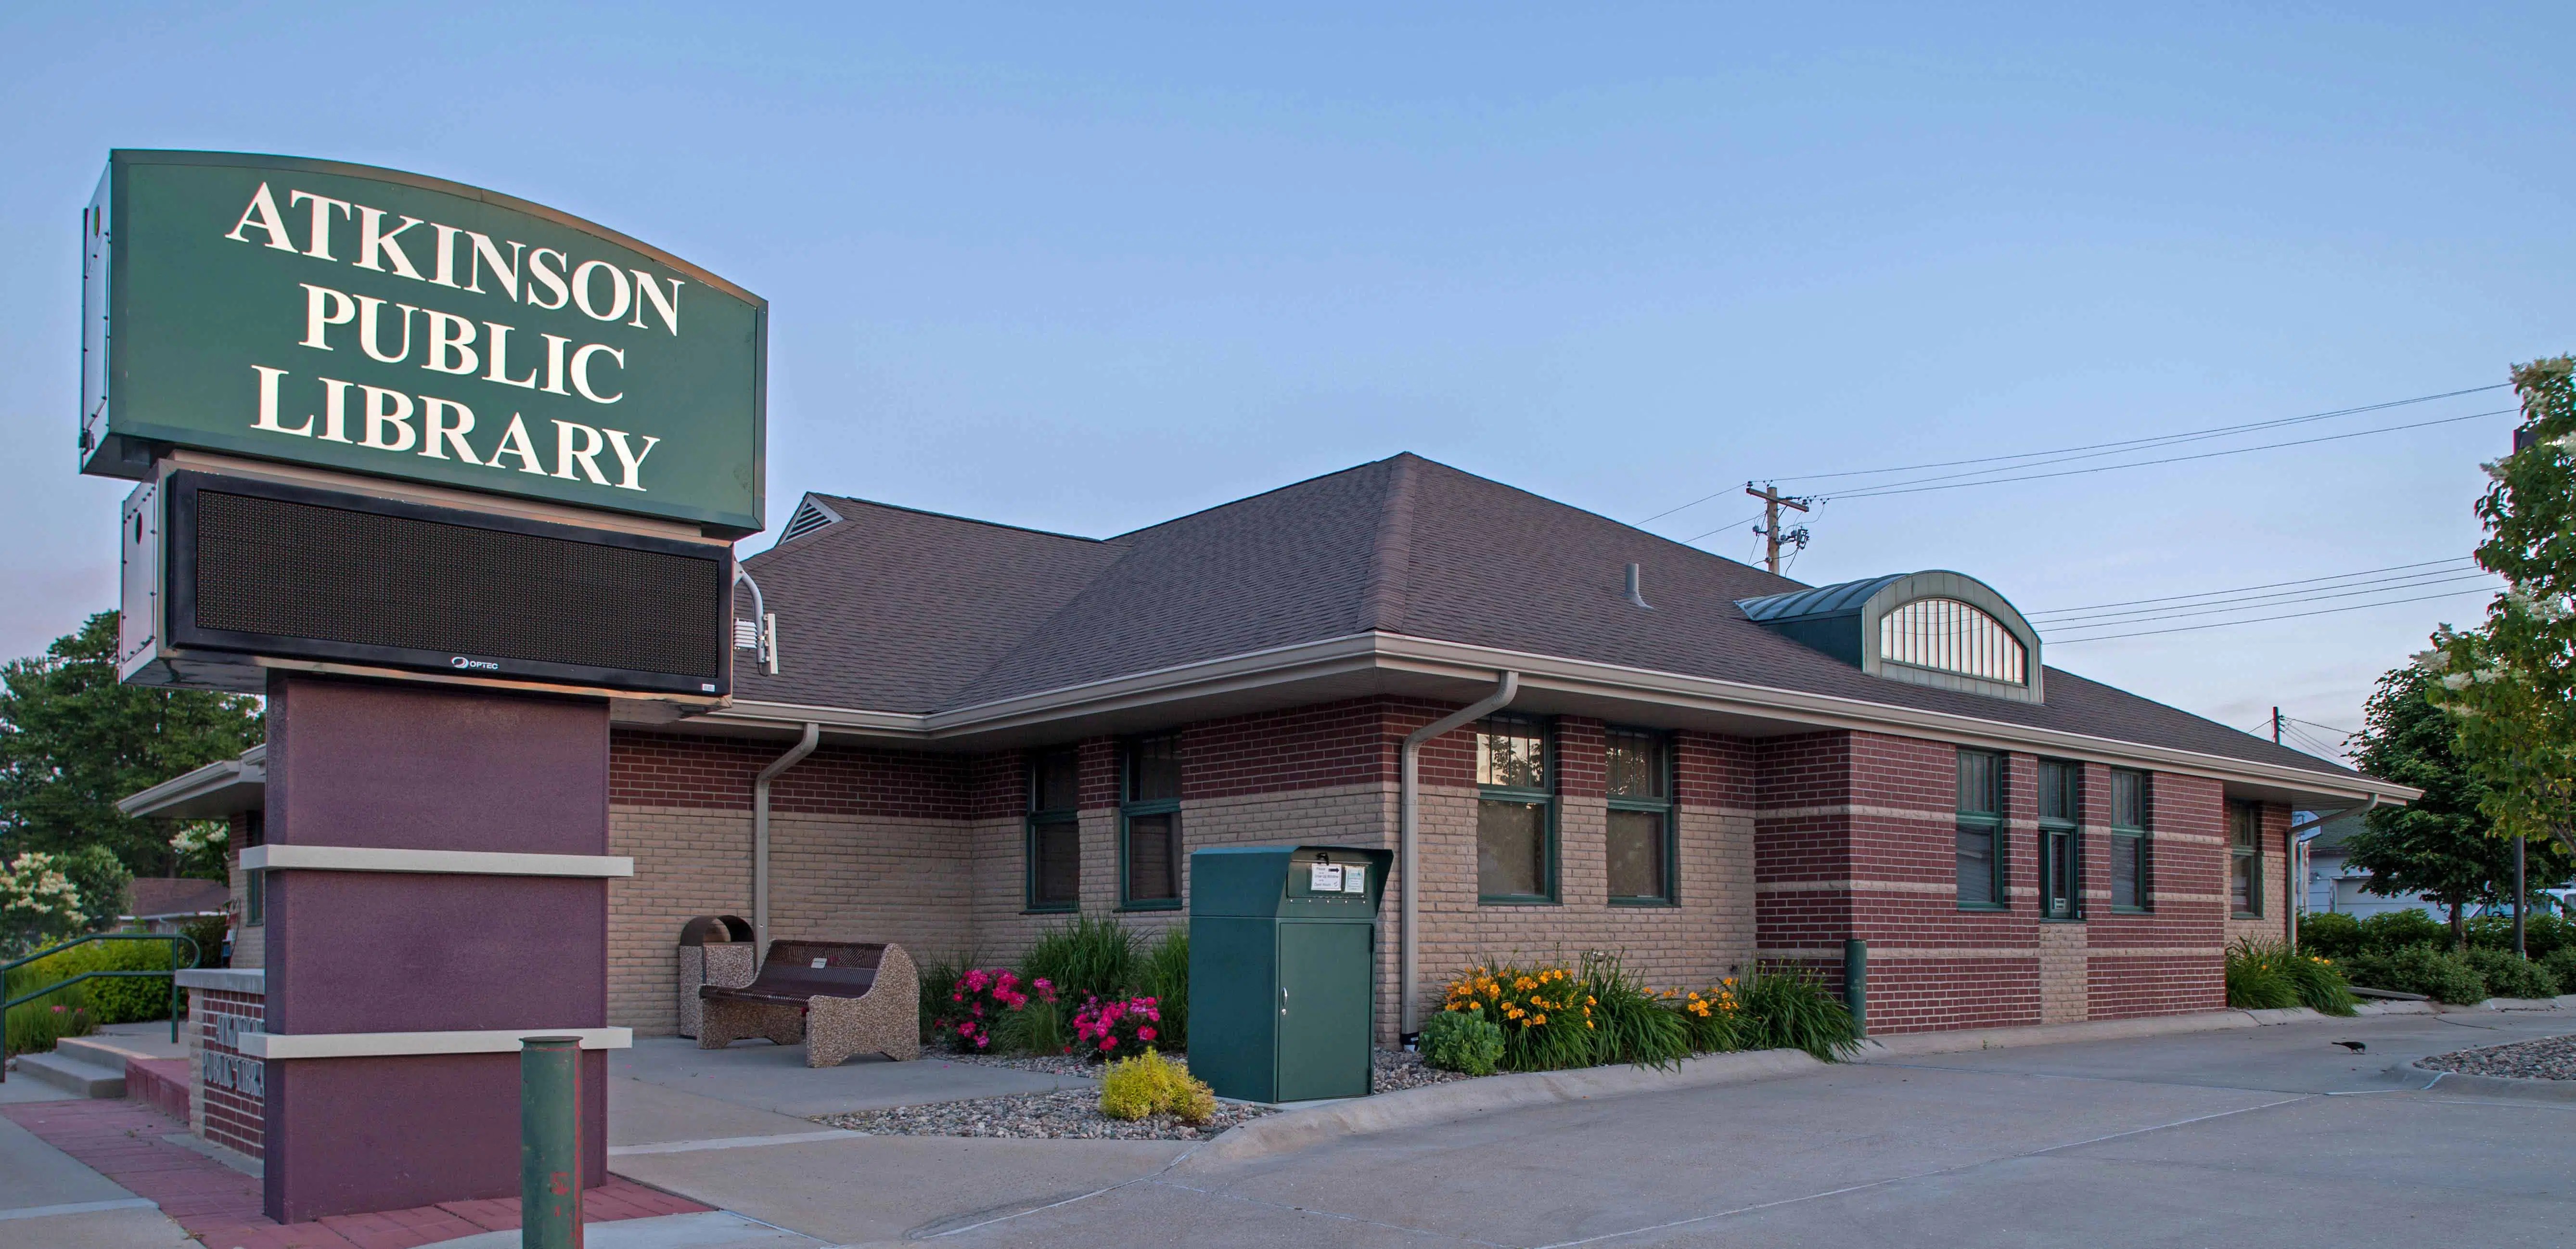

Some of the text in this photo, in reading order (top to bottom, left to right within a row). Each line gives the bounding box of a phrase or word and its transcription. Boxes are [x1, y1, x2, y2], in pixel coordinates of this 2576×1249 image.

[224, 182, 685, 336] ATKINSON
[298, 283, 626, 404] PUBLIC
[250, 364, 661, 492] LIBRARY
[470, 660, 499, 670] OPTEC
